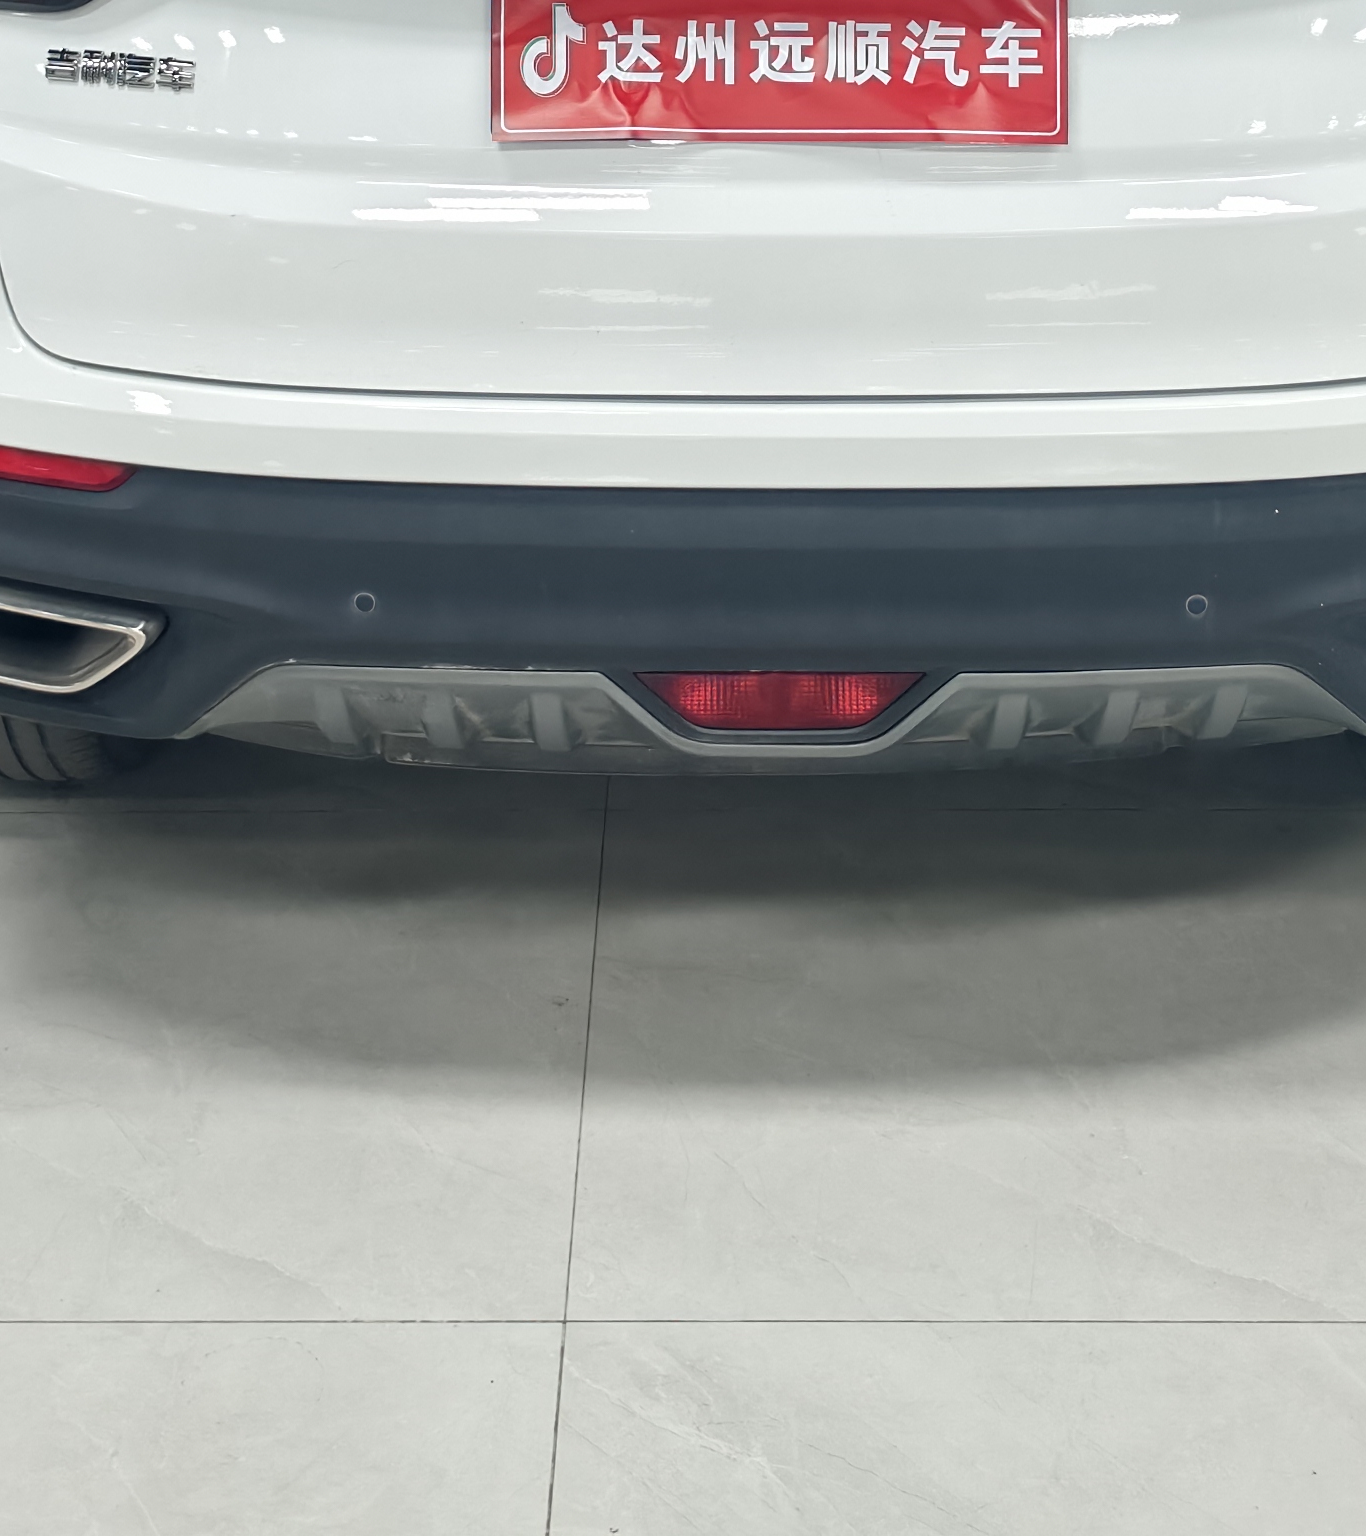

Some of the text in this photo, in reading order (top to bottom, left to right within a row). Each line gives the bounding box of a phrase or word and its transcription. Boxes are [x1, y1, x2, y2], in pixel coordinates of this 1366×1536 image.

[596, 19, 1045, 88] 达州远顺汽车
